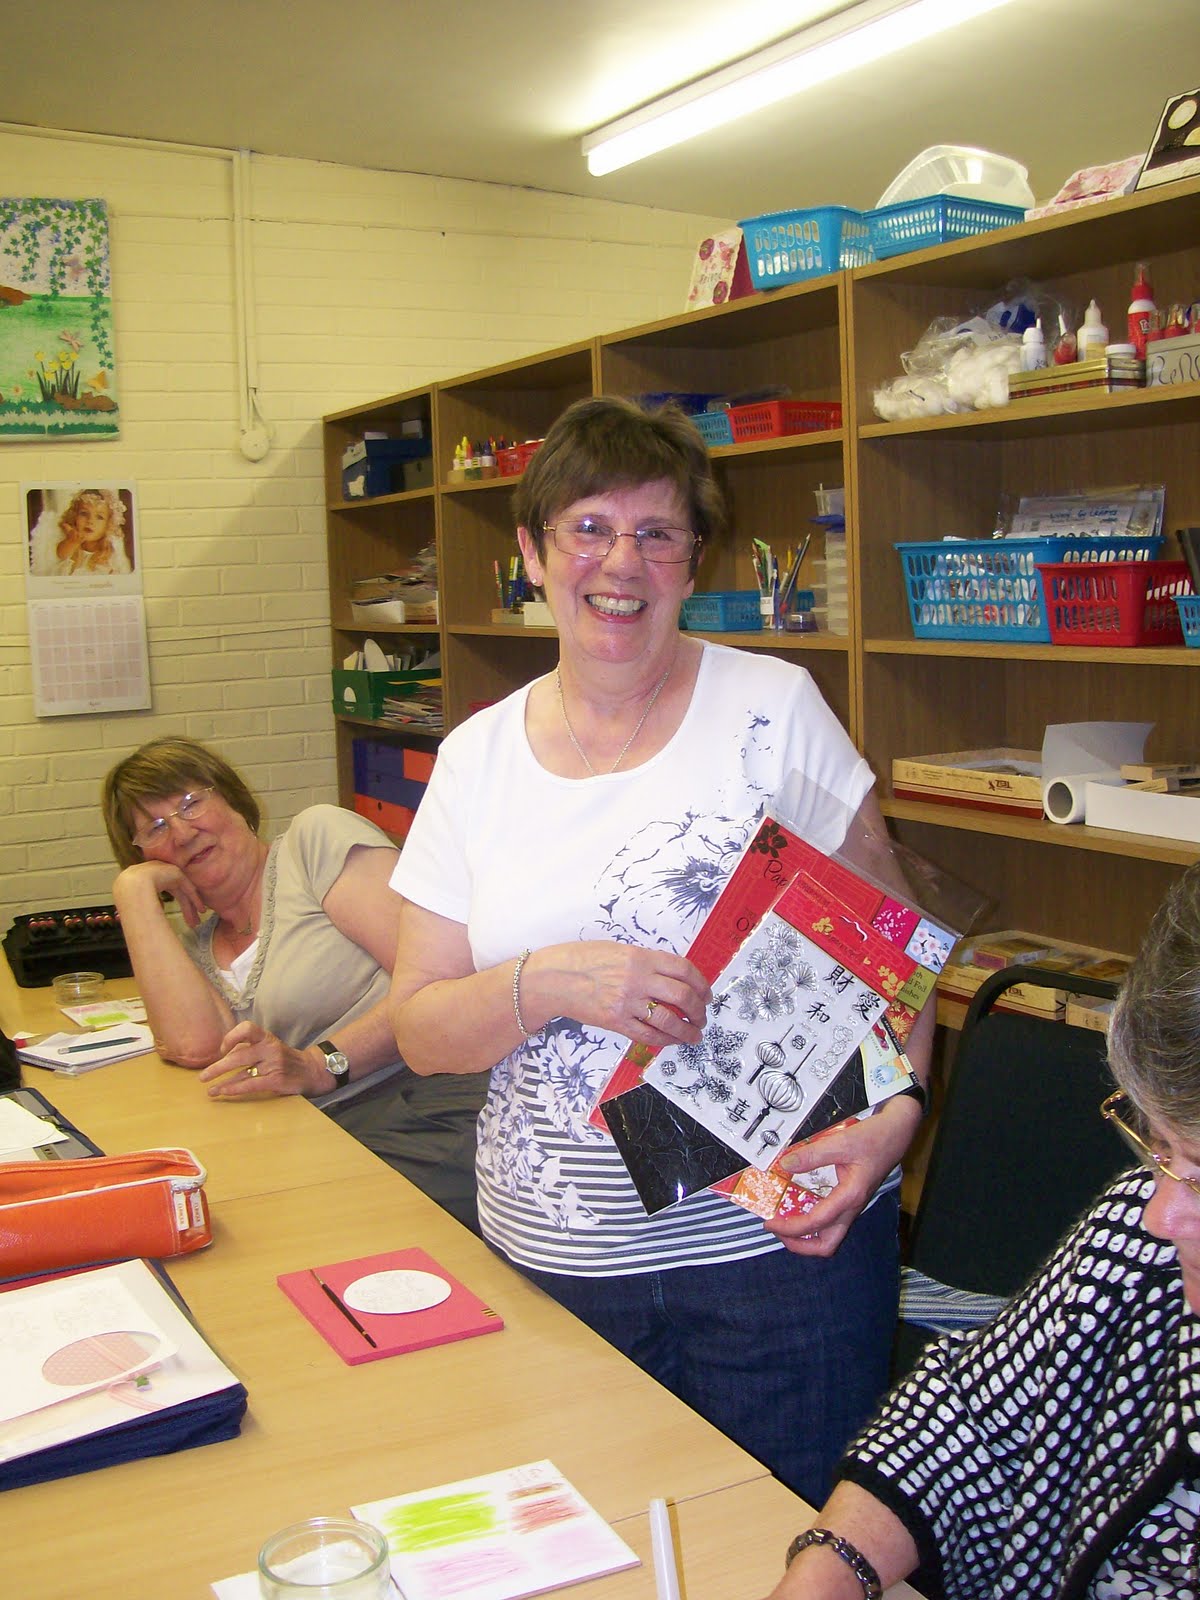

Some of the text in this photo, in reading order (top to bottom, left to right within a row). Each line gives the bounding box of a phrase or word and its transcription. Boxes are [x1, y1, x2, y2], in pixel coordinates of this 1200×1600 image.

[824, 964, 855, 993] 財
[806, 1002, 831, 1023] 和
[853, 991, 882, 1022] 愛
[726, 1098, 751, 1122] 喜
